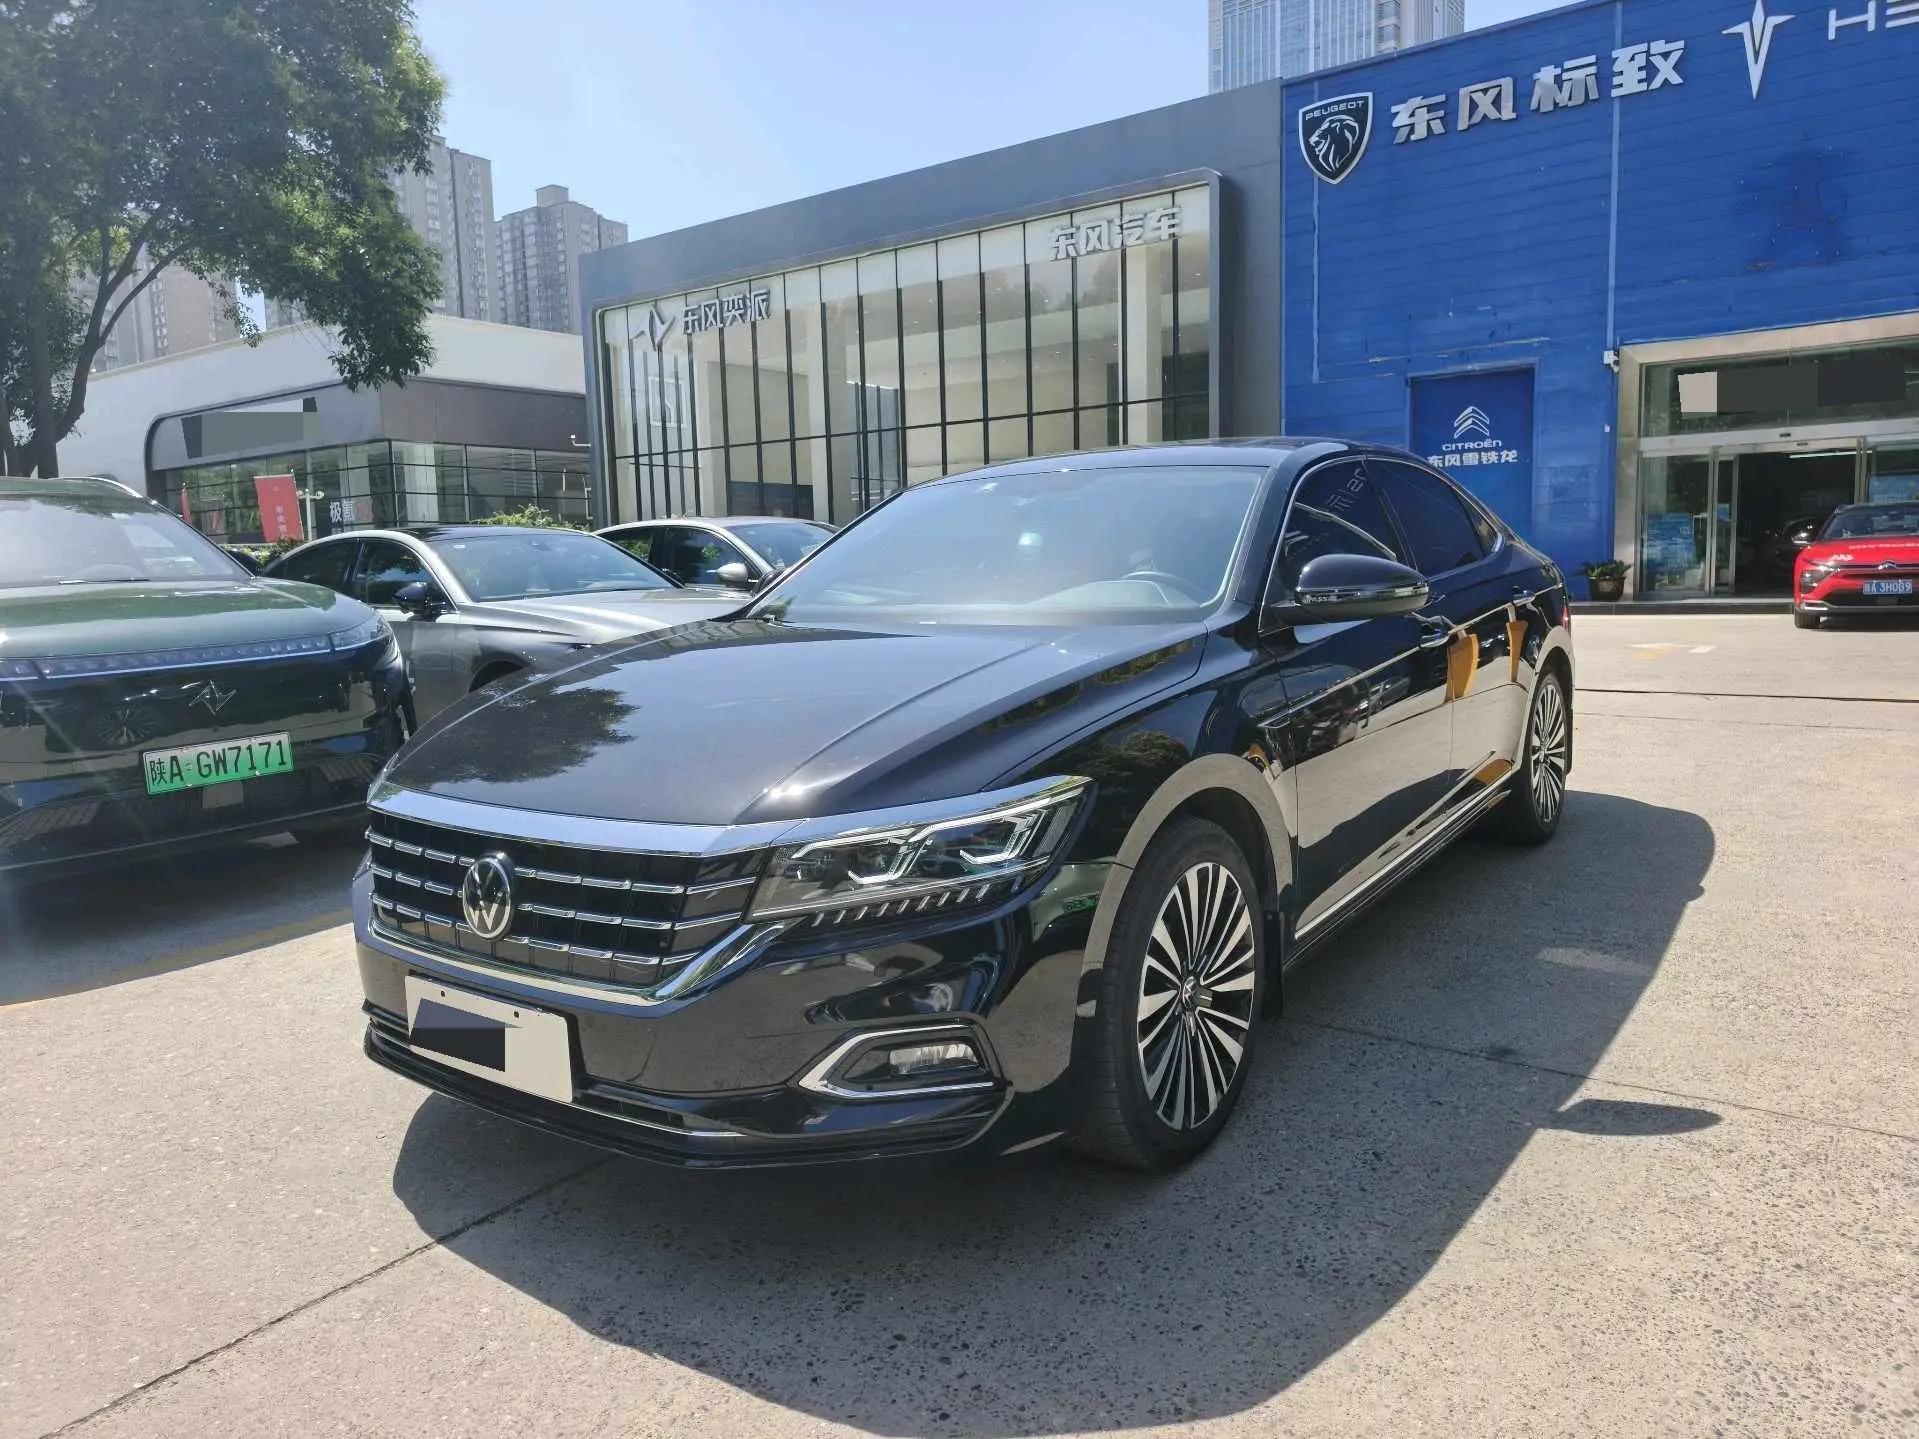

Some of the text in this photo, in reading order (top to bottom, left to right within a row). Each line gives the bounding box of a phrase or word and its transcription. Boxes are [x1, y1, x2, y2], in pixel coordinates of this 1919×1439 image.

[1305, 100, 1365, 121] PEUGEOT
[1390, 39, 1685, 144] 东风标致
[1050, 206, 1183, 261] 东风汽车
[682, 288, 770, 335] 东风奕派
[1427, 449, 1518, 467] 东风雪铁龙
[196, 739, 287, 778] GW7171
